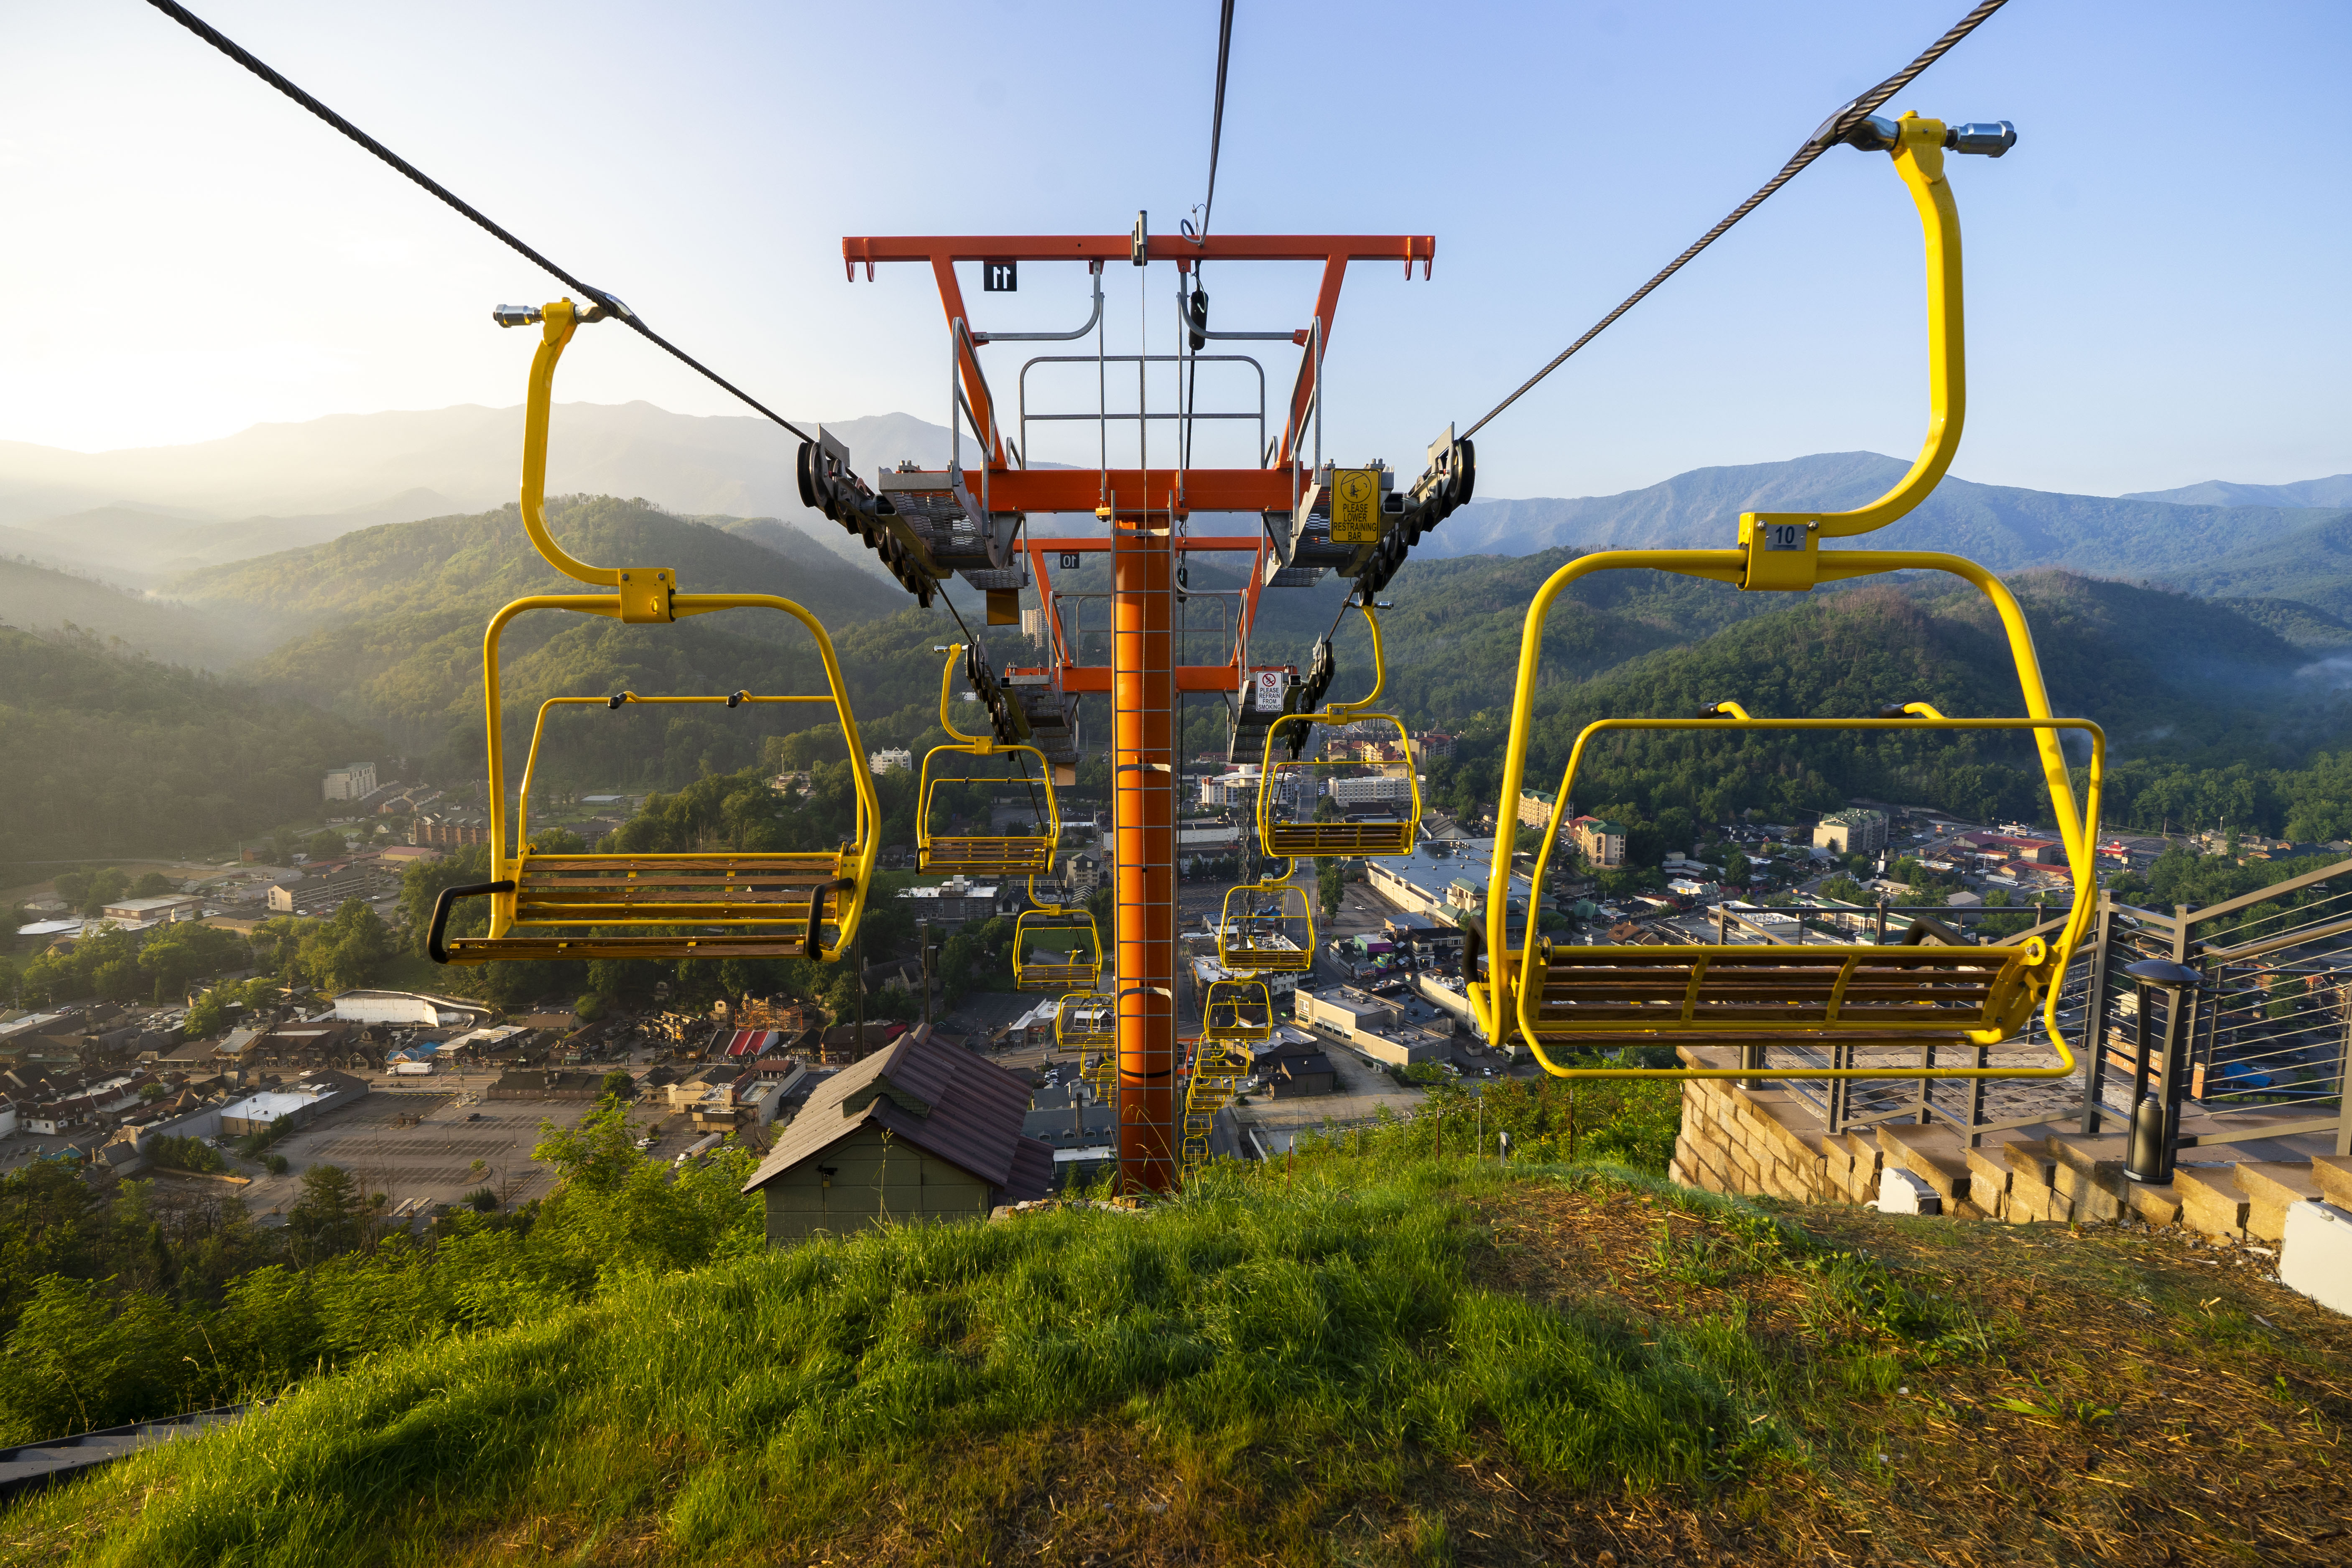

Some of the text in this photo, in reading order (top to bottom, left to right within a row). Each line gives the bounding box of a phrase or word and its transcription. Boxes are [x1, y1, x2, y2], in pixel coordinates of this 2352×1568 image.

[1343, 503, 1368, 513] PLEASE
[1343, 513, 1367, 522] LOWER
[1333, 522, 1377, 532] RESTRAINING
[1348, 532, 1362, 541] BAR
[1775, 525, 1795, 544] 10
